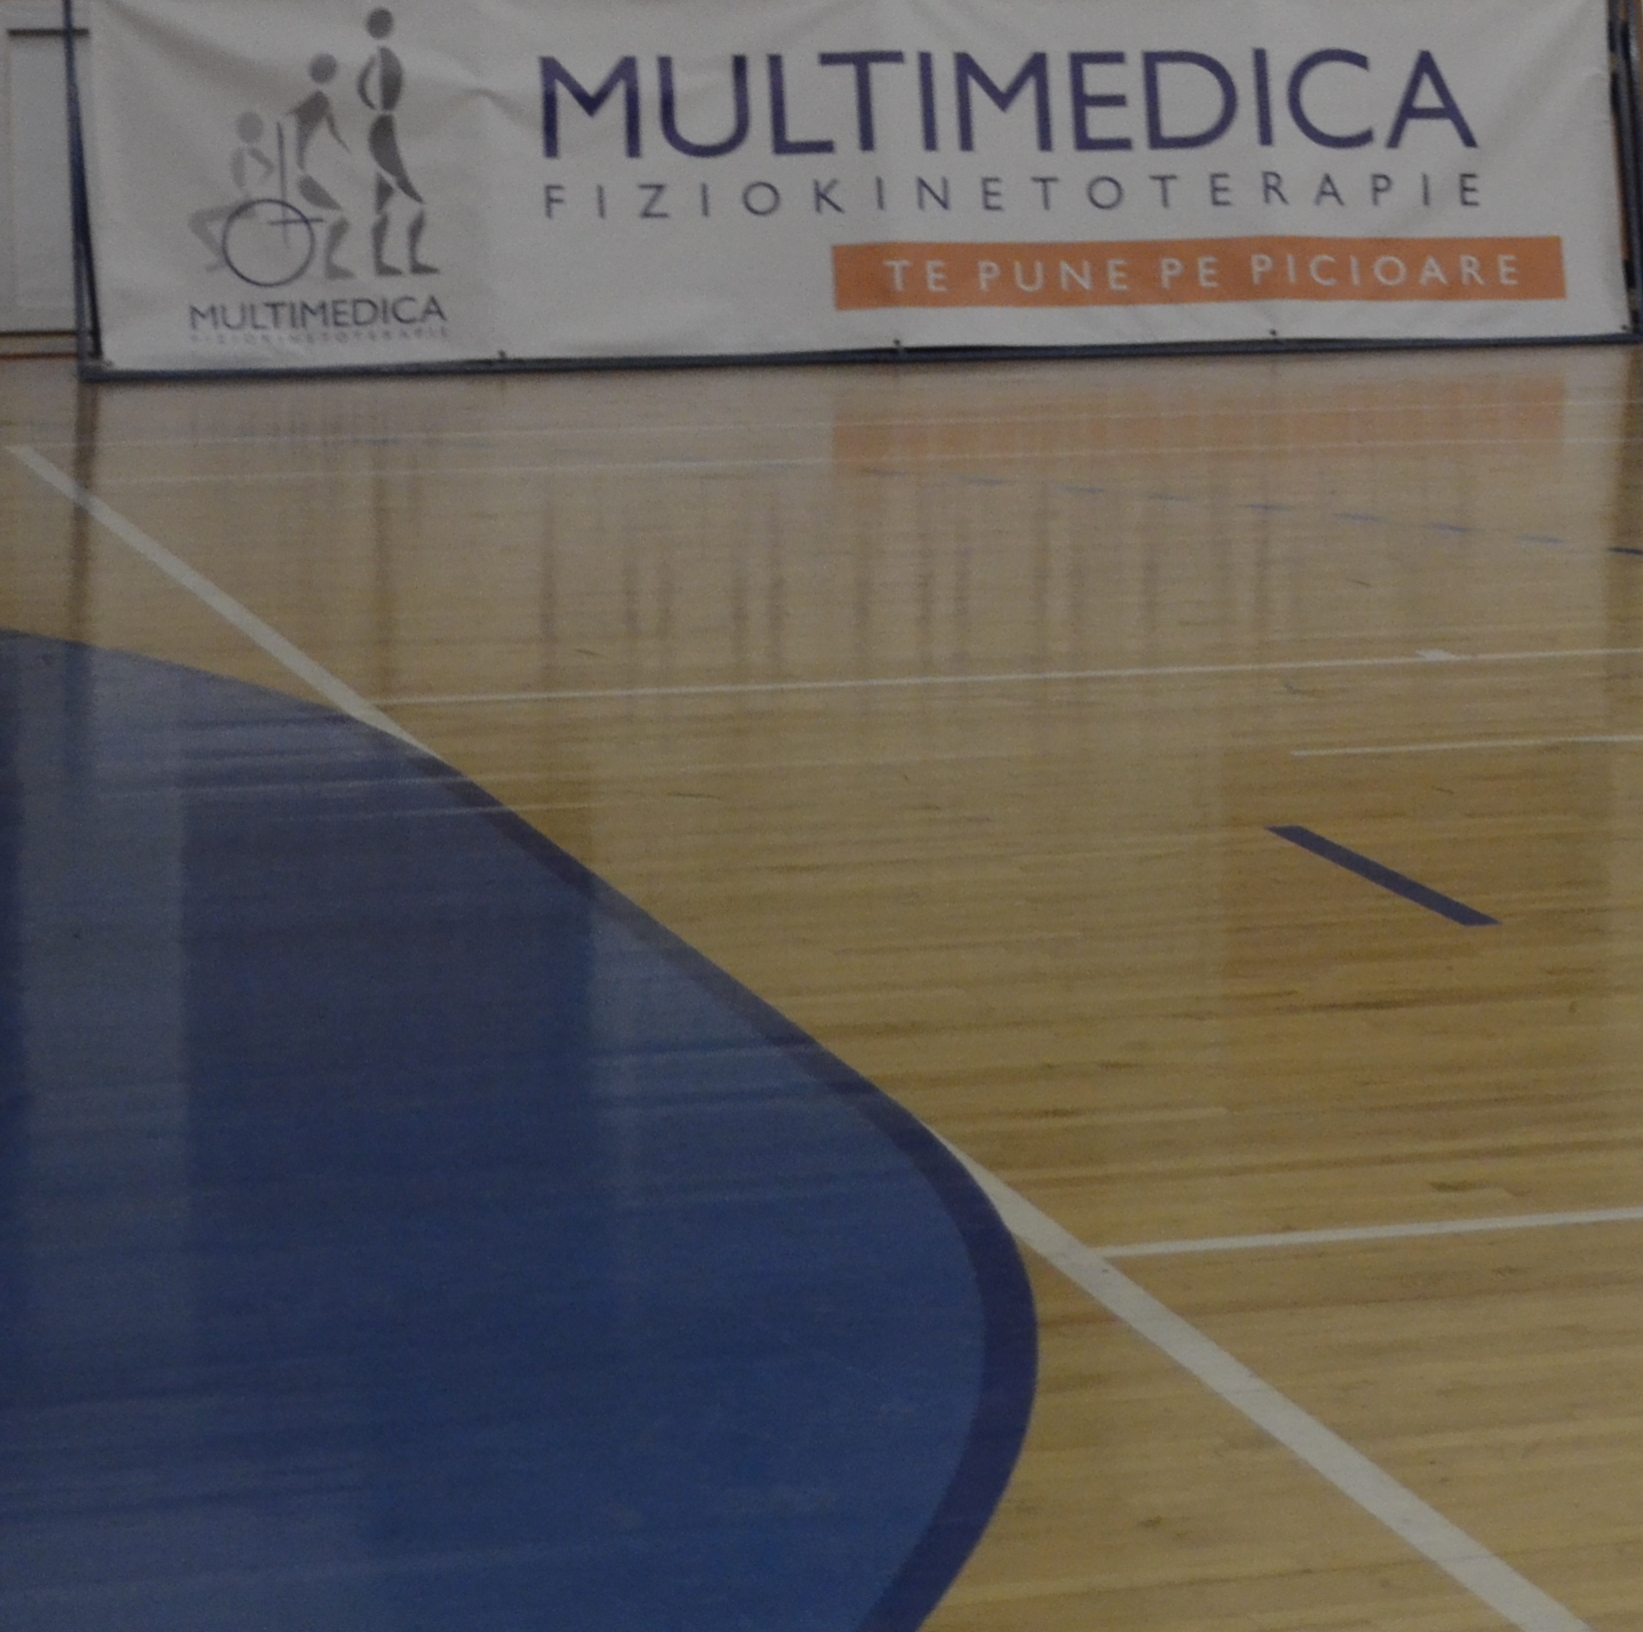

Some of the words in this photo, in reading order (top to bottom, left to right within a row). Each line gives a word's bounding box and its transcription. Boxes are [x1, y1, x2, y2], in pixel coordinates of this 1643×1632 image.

[538, 48, 1478, 159] MULTIMEDICA
[544, 171, 1482, 221] FIZIOKINETOTERAPIE
[883, 258, 948, 294] TE
[977, 257, 1129, 294] PUNE
[1160, 255, 1221, 291] PE
[1250, 252, 1520, 289] PICIOARE
[189, 296, 448, 331] MULTIMEDICA
